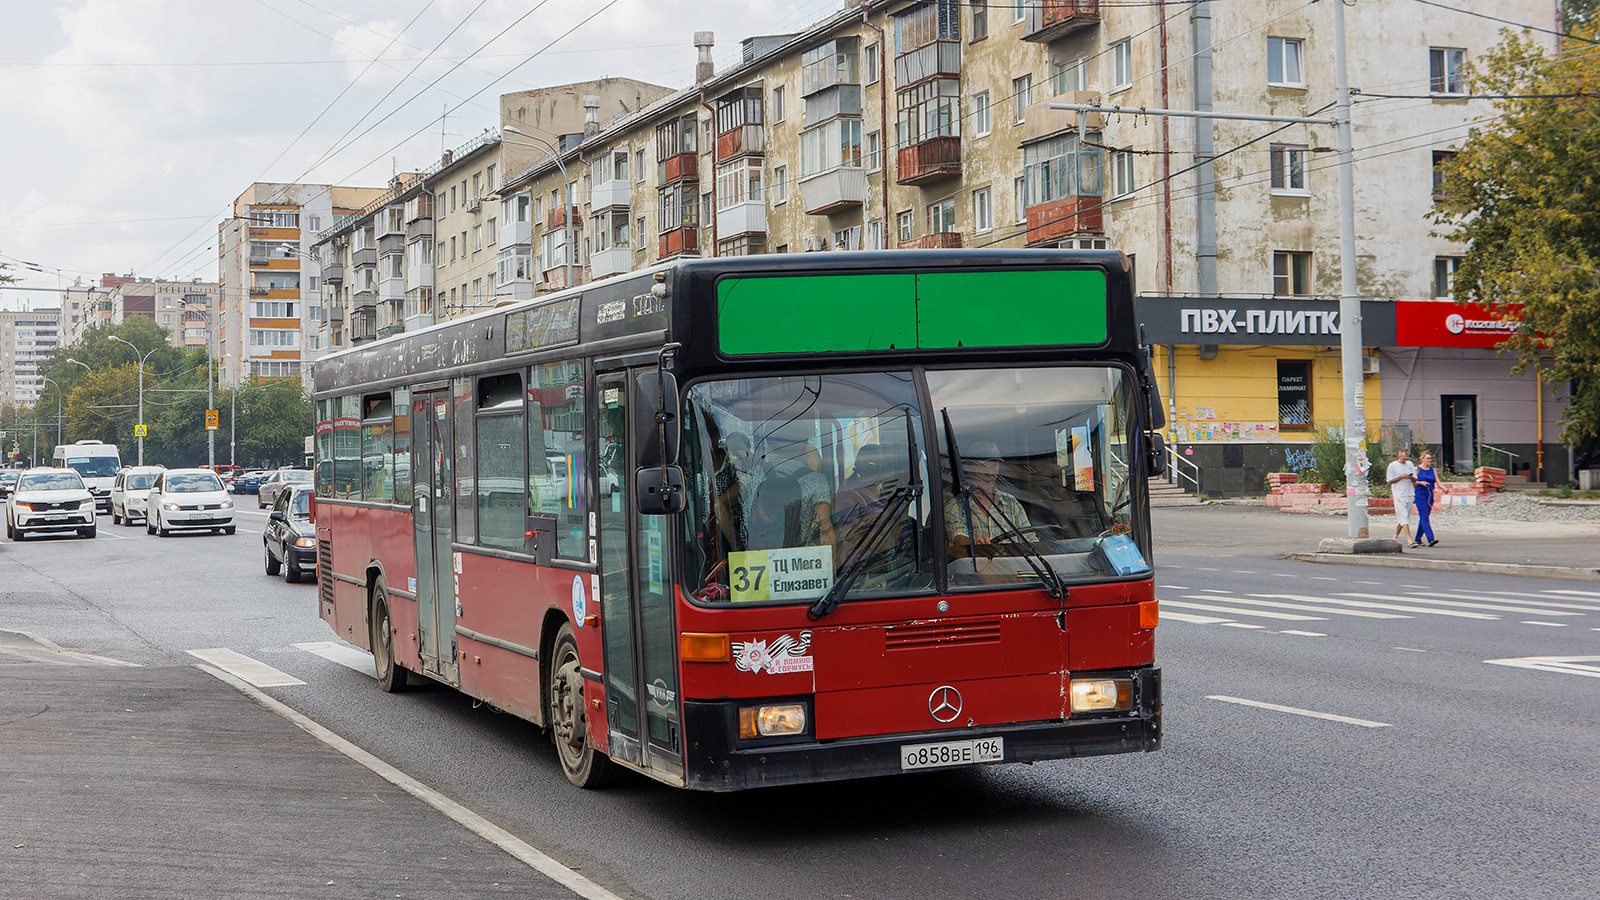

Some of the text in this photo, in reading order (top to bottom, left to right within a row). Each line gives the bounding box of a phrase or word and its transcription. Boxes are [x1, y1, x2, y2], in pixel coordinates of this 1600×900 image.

[1181, 309, 1342, 335] ПВХ-ПЛИТК
[773, 558, 822, 573] ТЦ Мега
[733, 565, 766, 592] 37
[774, 578, 828, 593] Елизавет
[907, 741, 998, 766] О858ВЕ 196
